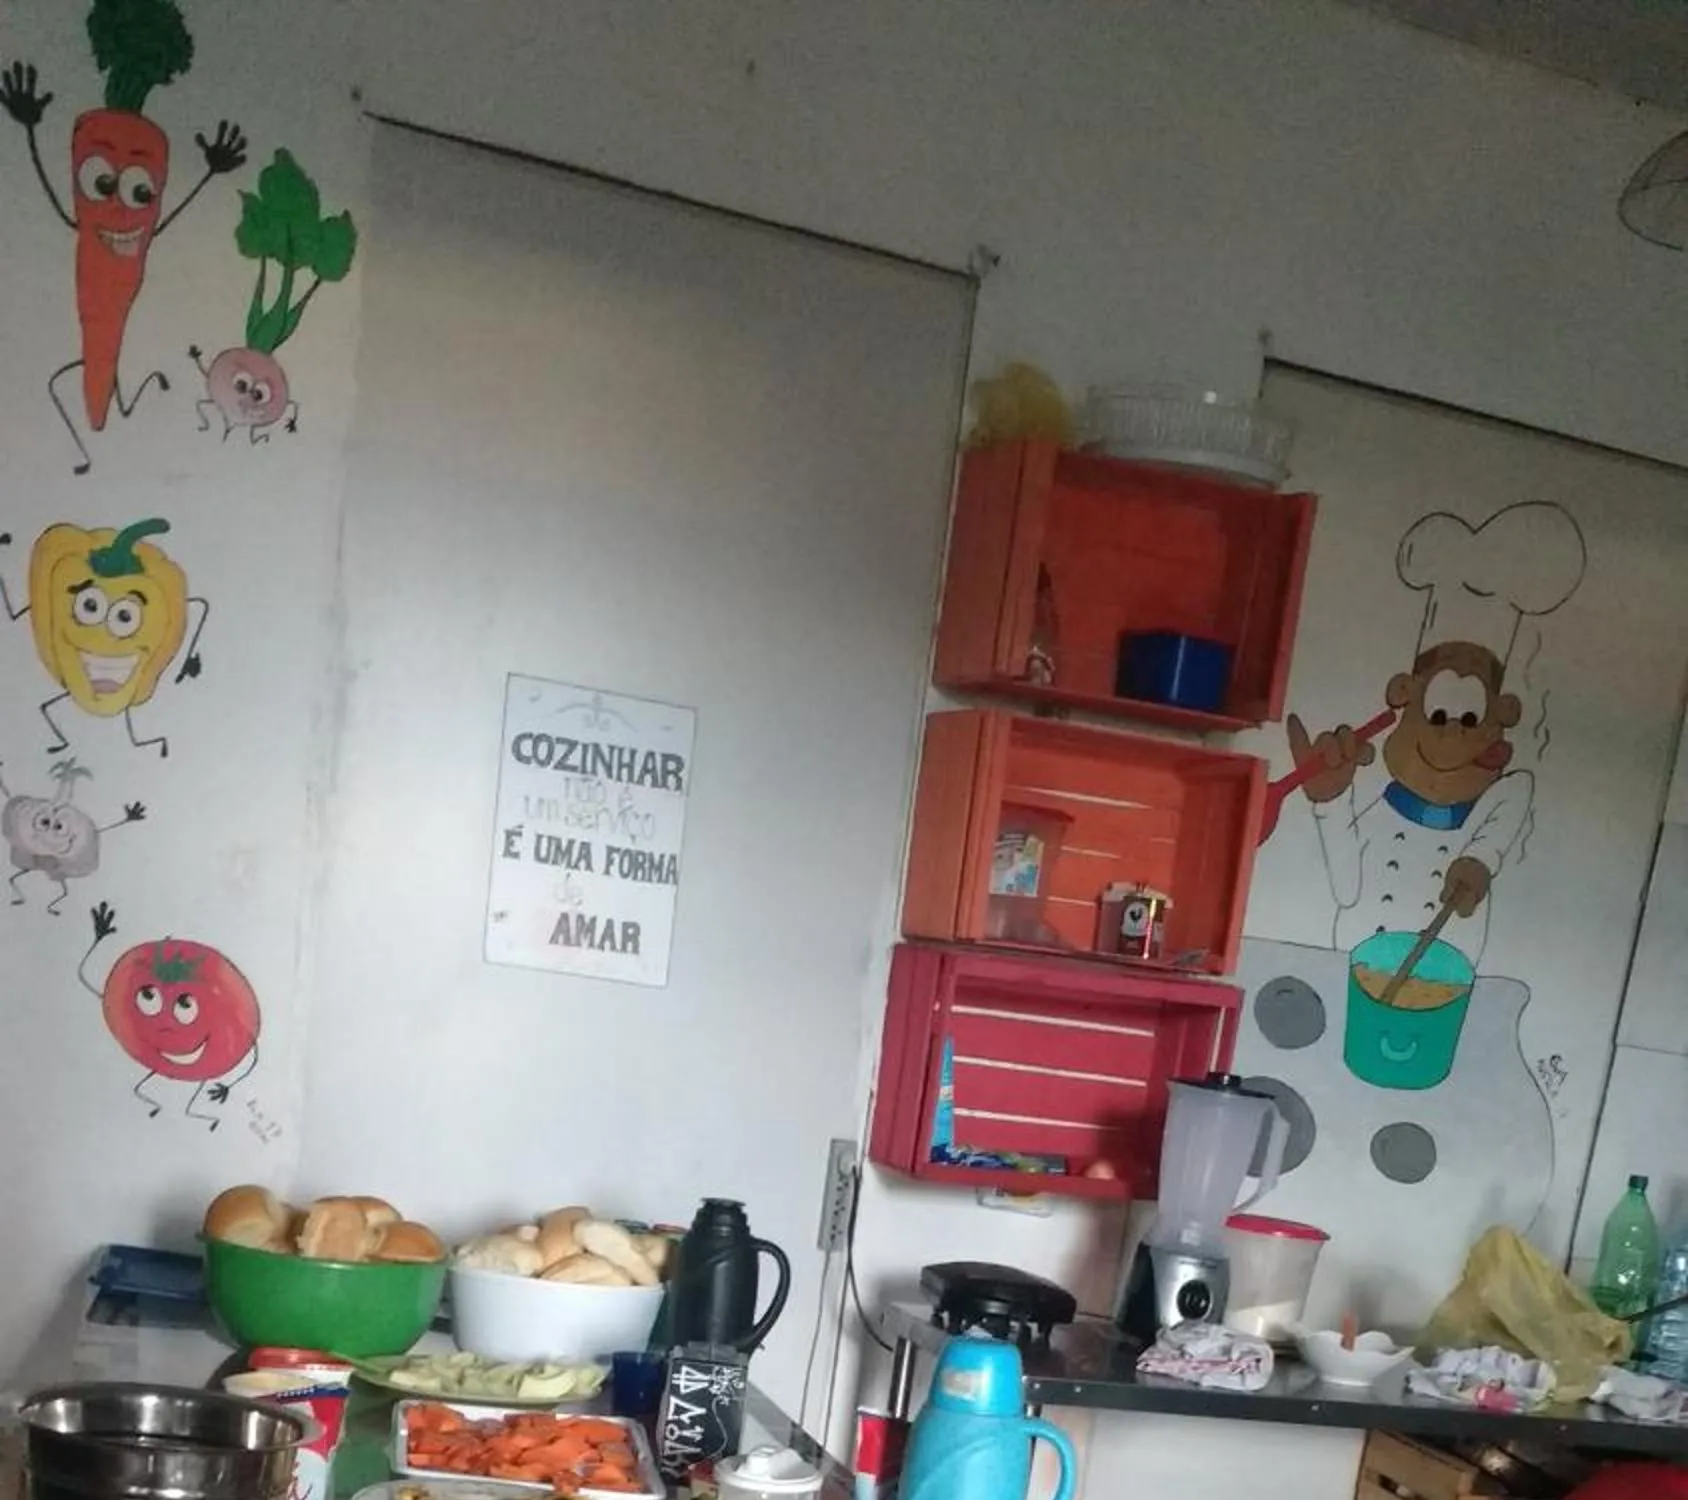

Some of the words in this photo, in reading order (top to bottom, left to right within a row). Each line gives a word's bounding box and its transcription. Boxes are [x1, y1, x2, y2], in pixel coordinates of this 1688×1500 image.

[511, 732, 685, 792] COZINHAR
[502, 823, 525, 859] É
[533, 834, 594, 873] UMA
[603, 844, 679, 886] FORMA
[549, 911, 642, 955] AMAR
